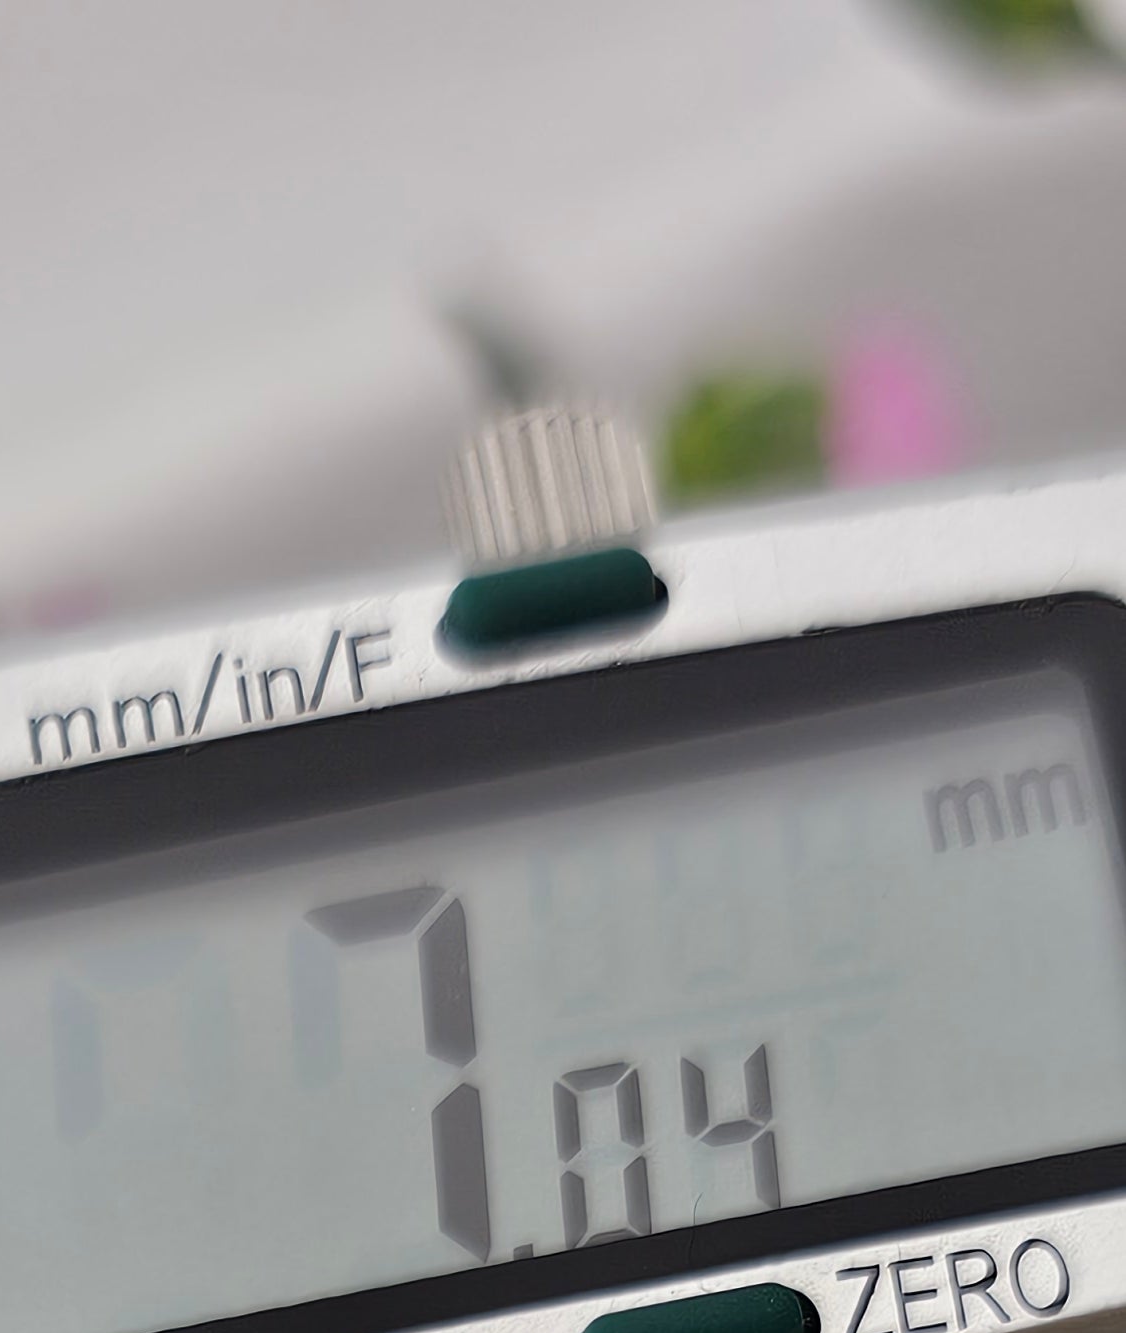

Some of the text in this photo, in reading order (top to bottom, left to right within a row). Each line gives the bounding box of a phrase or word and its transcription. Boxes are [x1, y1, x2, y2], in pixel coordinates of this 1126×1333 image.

[29, 630, 392, 764] mm/in/F
[924, 763, 1088, 853] mm
[304, 887, 780, 1262] 7.04
